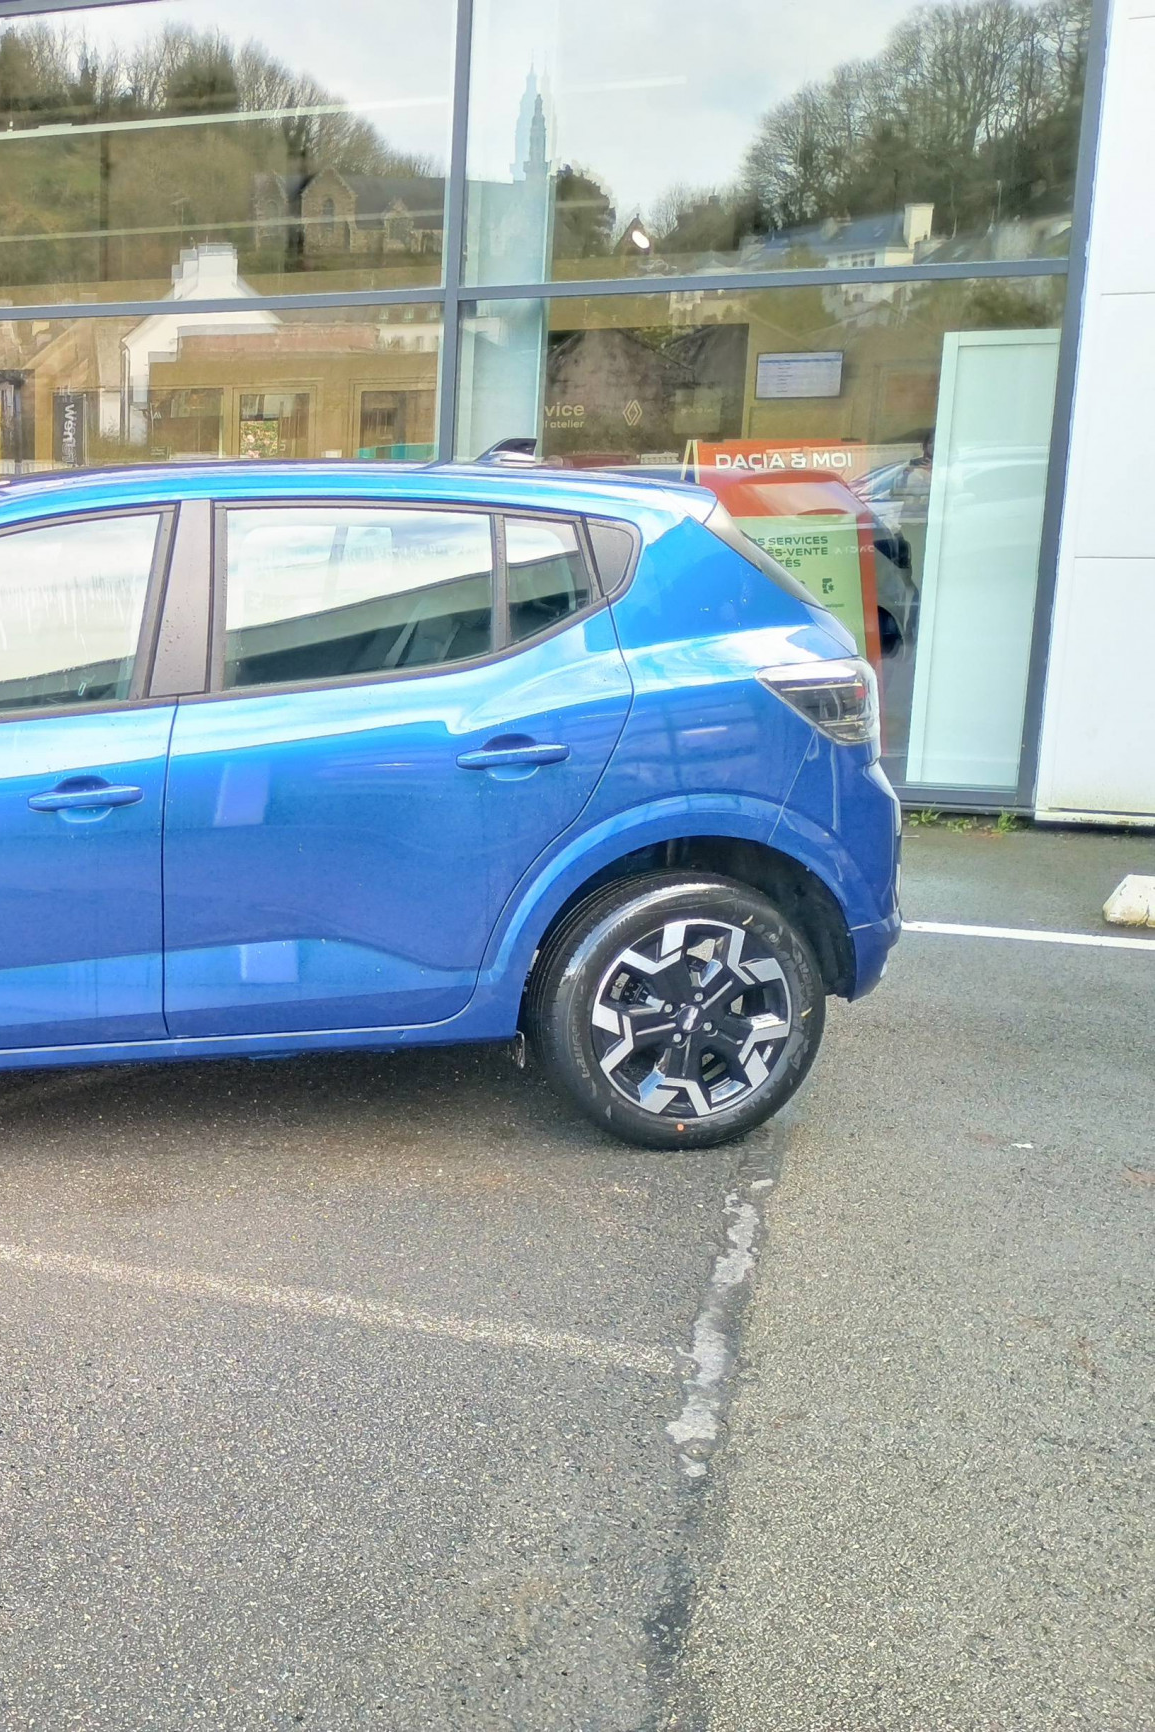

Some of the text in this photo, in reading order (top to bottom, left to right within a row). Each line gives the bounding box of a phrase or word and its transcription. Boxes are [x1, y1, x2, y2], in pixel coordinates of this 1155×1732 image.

[545, 402, 585, 417] vice
[550, 419, 584, 429] atelier
[715, 452, 853, 469] DACIA & MOI
[768, 536, 828, 546] SERVICES
[767, 546, 829, 557] ÈS-VENTE
